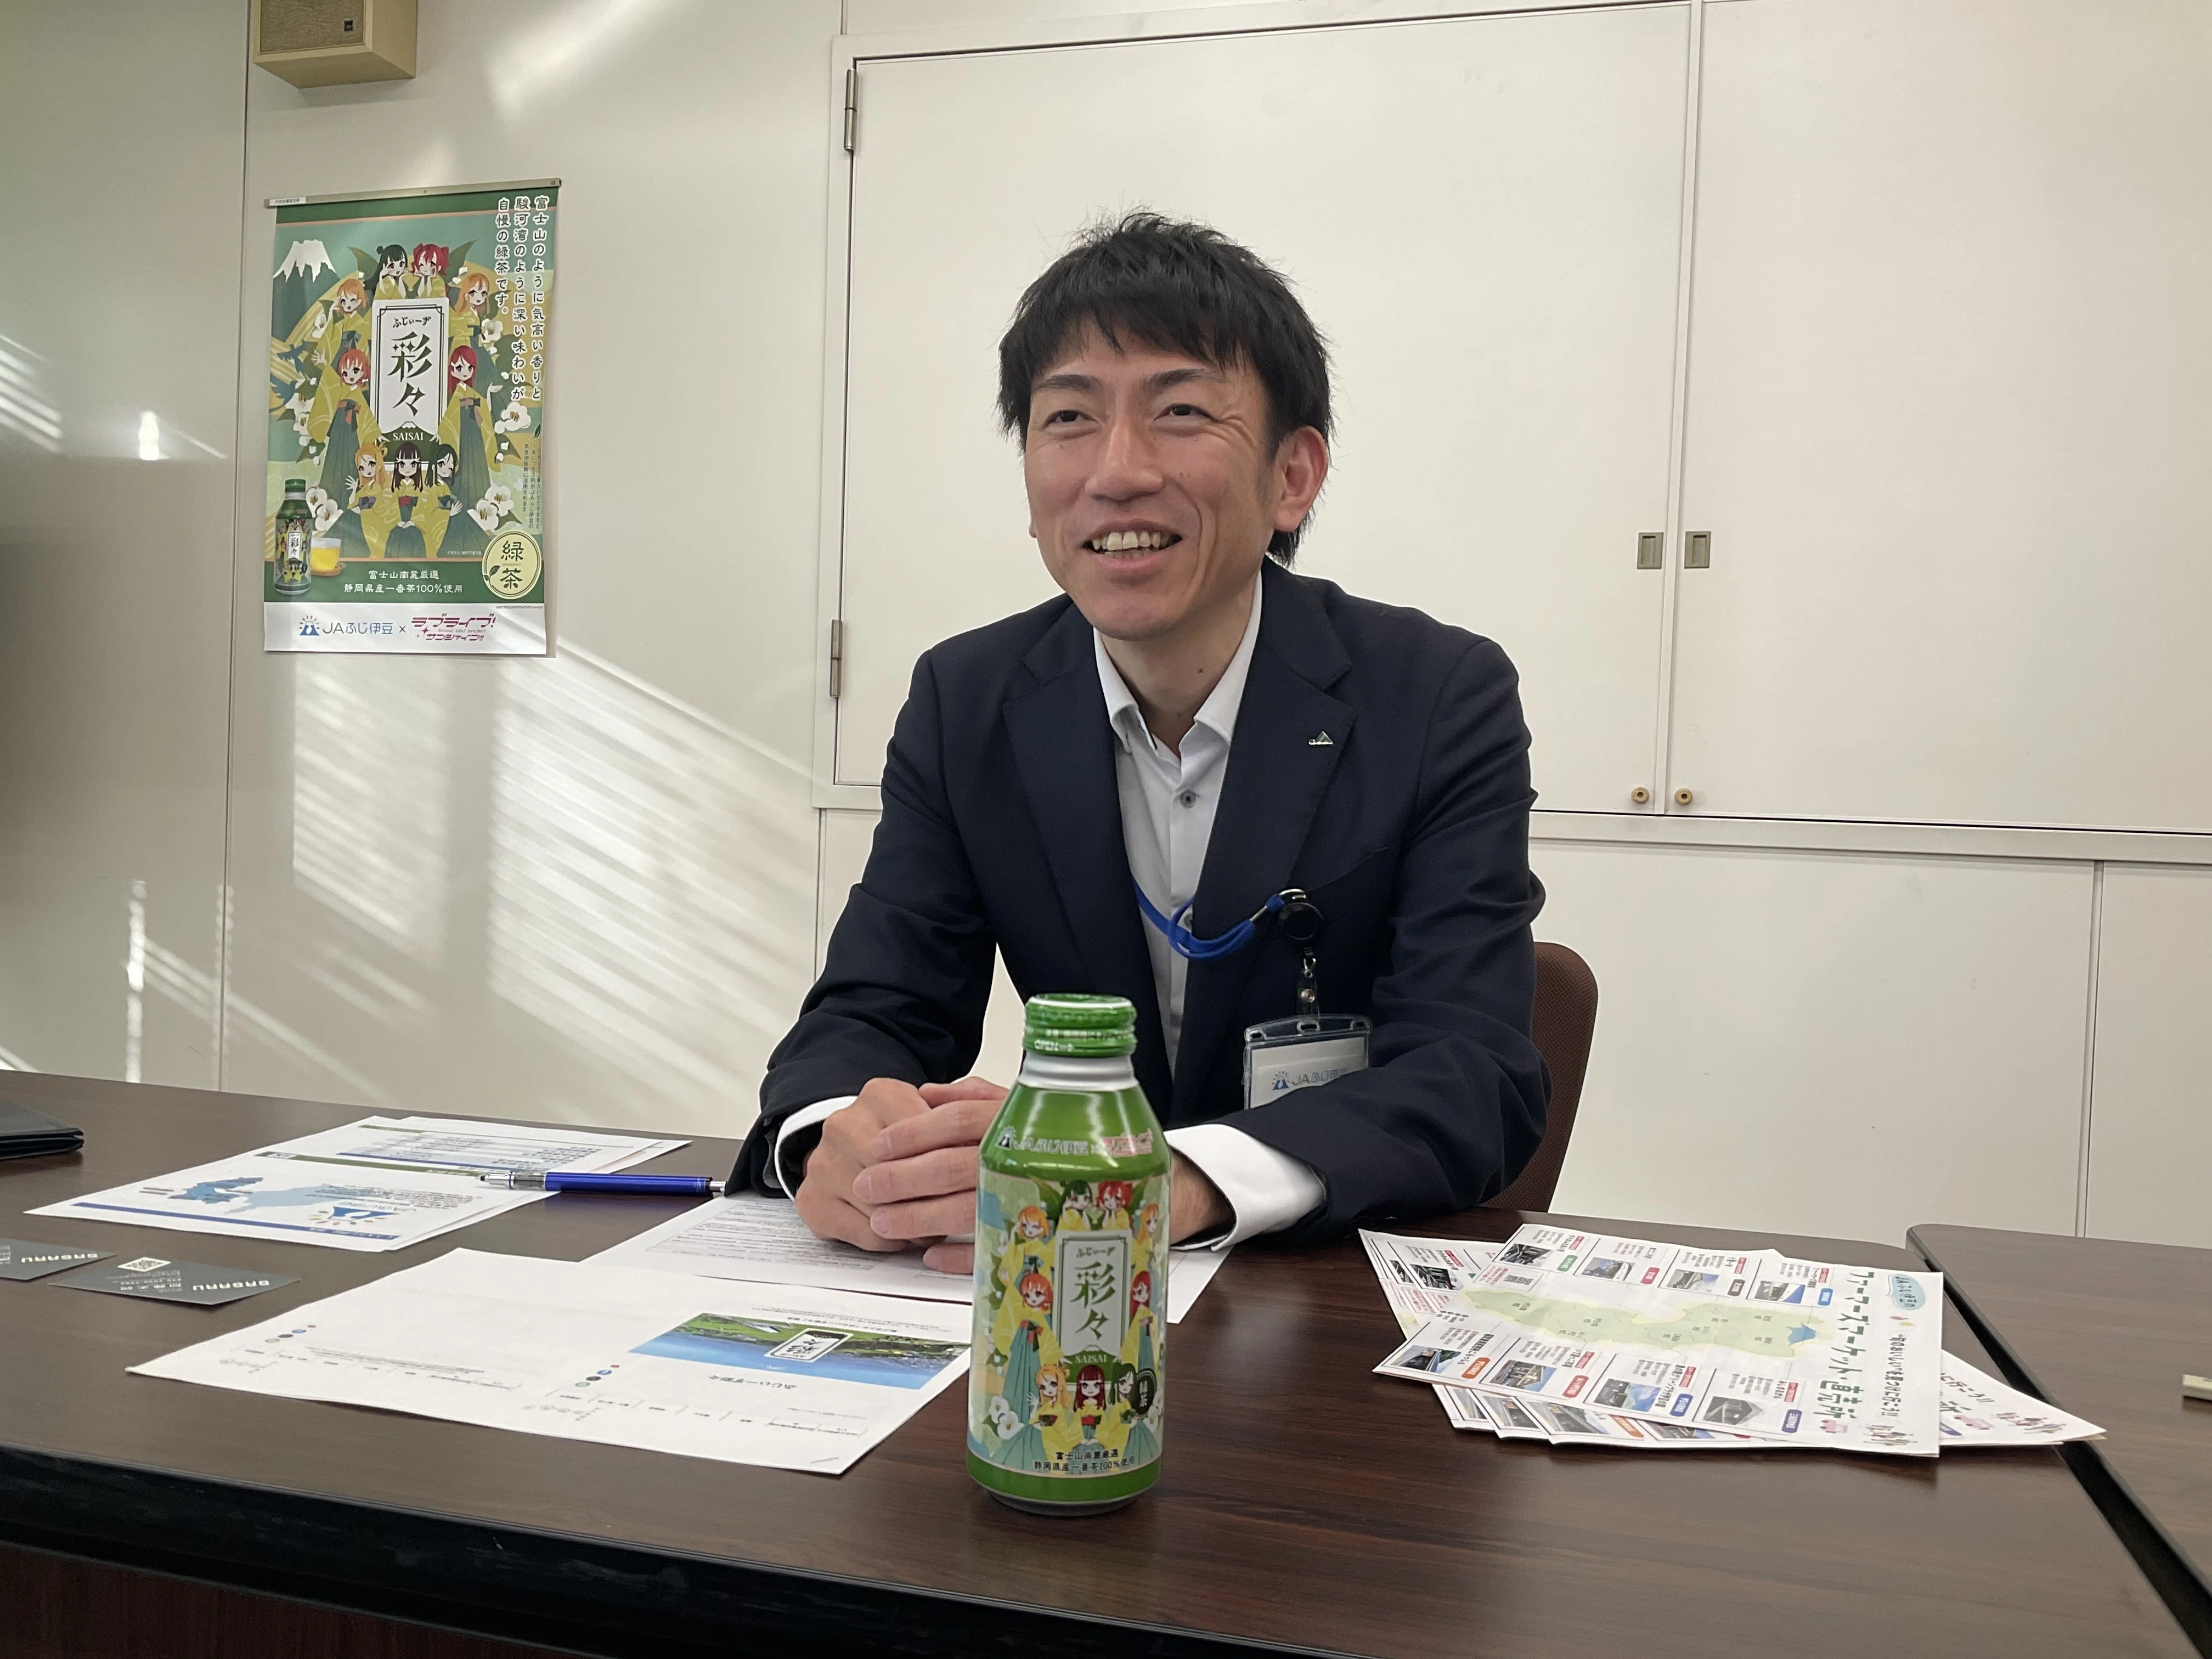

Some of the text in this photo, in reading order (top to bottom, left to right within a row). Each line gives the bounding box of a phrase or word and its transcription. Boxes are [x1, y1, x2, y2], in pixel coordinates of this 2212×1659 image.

[495, 198, 510, 314] 自慢の緑茶です。
[512, 196, 530, 400] 駿河湾のように深い味わいが
[531, 195, 549, 400] 富士山のように気高い香りと
[387, 331, 433, 417] 彩々
[393, 432, 424, 441] SAISAI
[368, 570, 439, 579] 富士山南麓厳選
[500, 540, 524, 589] 緑茶
[323, 622, 393, 635] JAふじ伊豆
[1070, 1261, 1116, 1341] 彩々
